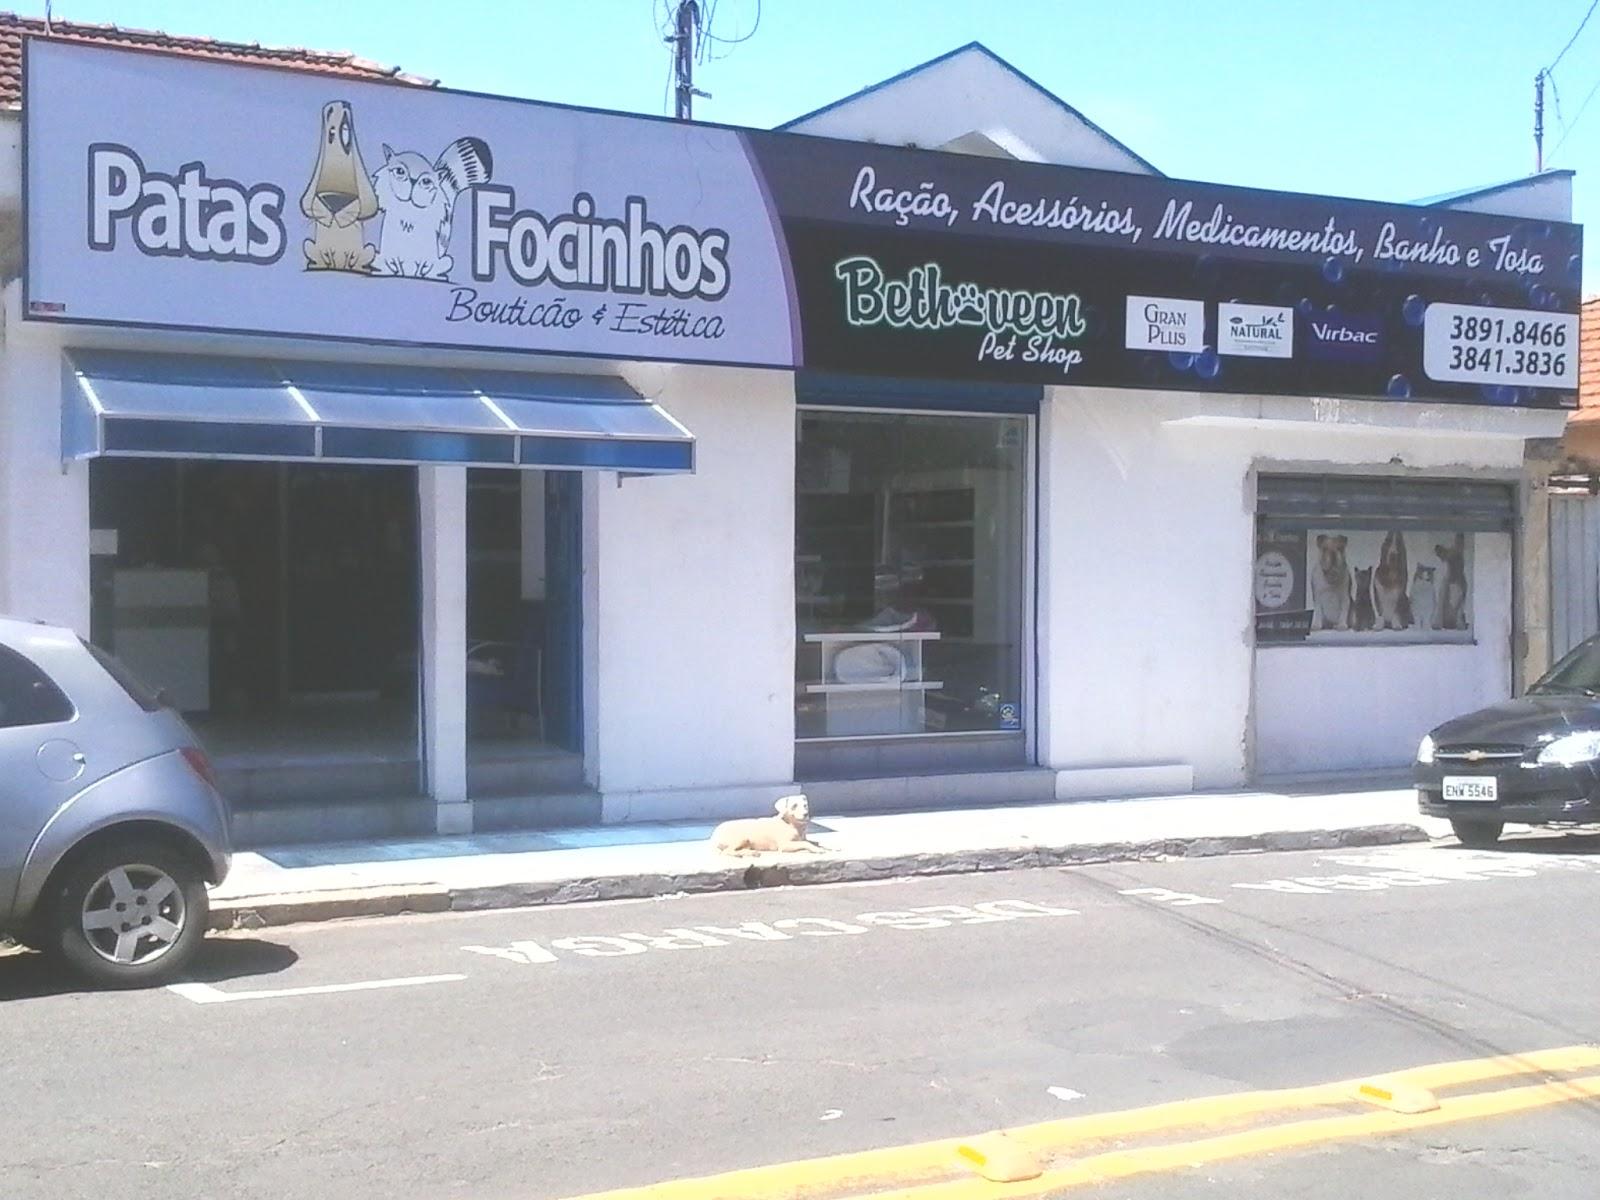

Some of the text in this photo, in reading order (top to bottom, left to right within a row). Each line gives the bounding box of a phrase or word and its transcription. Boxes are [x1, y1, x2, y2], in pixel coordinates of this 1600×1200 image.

[88, 143, 730, 301] Patas Focinhos
[850, 166, 1544, 275] Ração, Acessórios, Medicamentos, Banho e Tosa
[609, 303, 726, 339] Estética
[1230, 324, 1283, 340] NATURAL
[1311, 322, 1379, 344] Virbac
[1450, 315, 1566, 348] 3891.8466
[978, 332, 1083, 374] Pet Shop
[1449, 346, 1565, 376] 3841.3836
[459, 899, 1081, 964] DESCARGA
